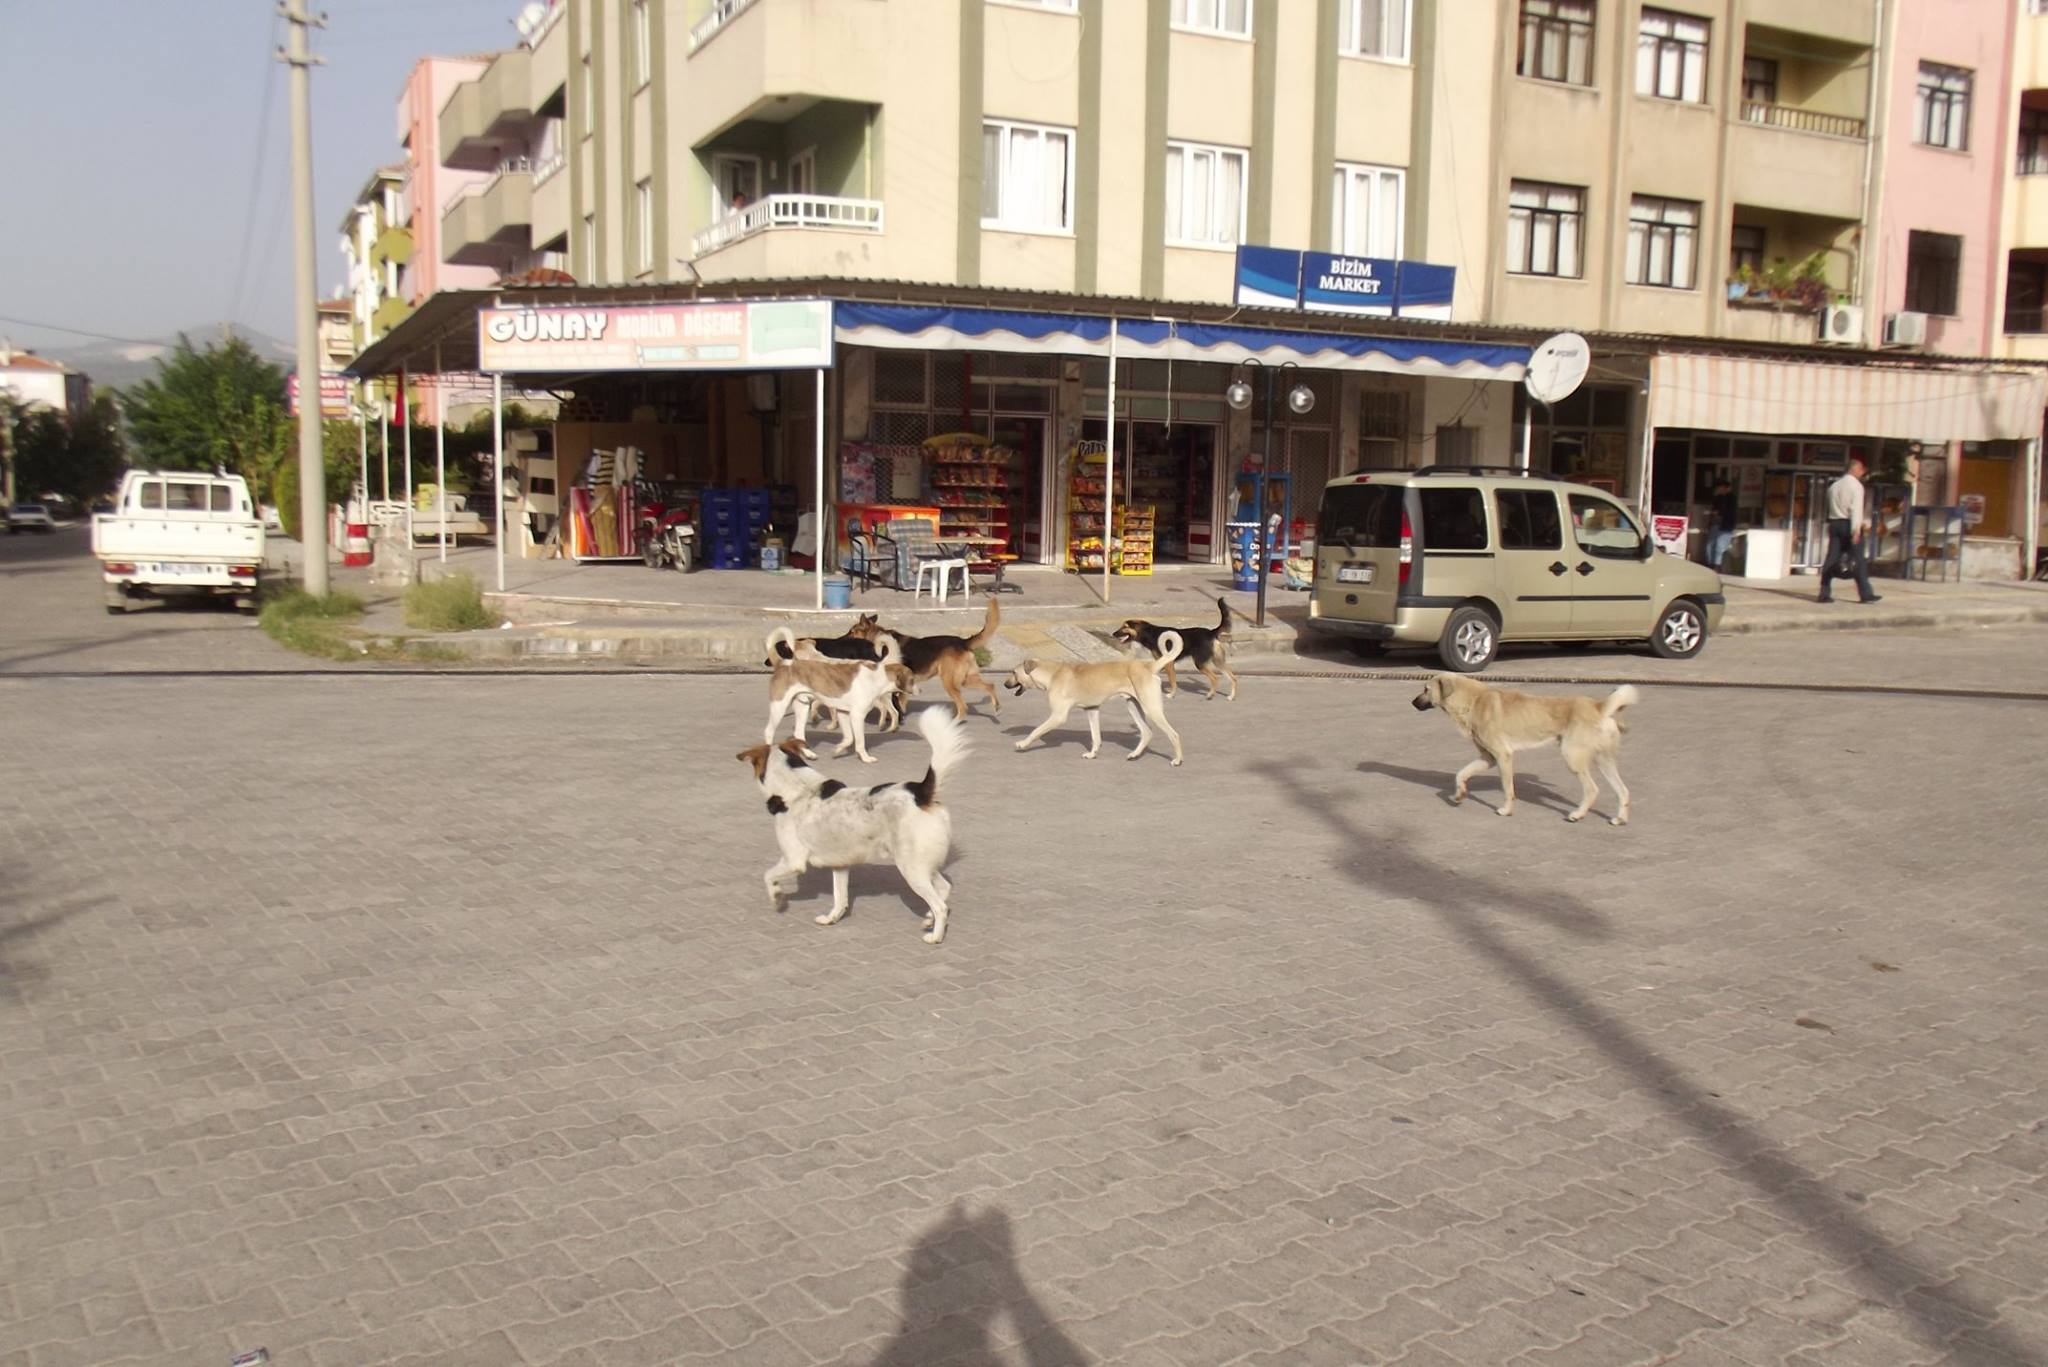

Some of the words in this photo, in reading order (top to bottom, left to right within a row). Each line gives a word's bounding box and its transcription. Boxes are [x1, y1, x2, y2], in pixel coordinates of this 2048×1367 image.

[1330, 257, 1372, 277] BİZİM
[1319, 275, 1381, 294] MARKET
[487, 309, 608, 342] GÜNAY
